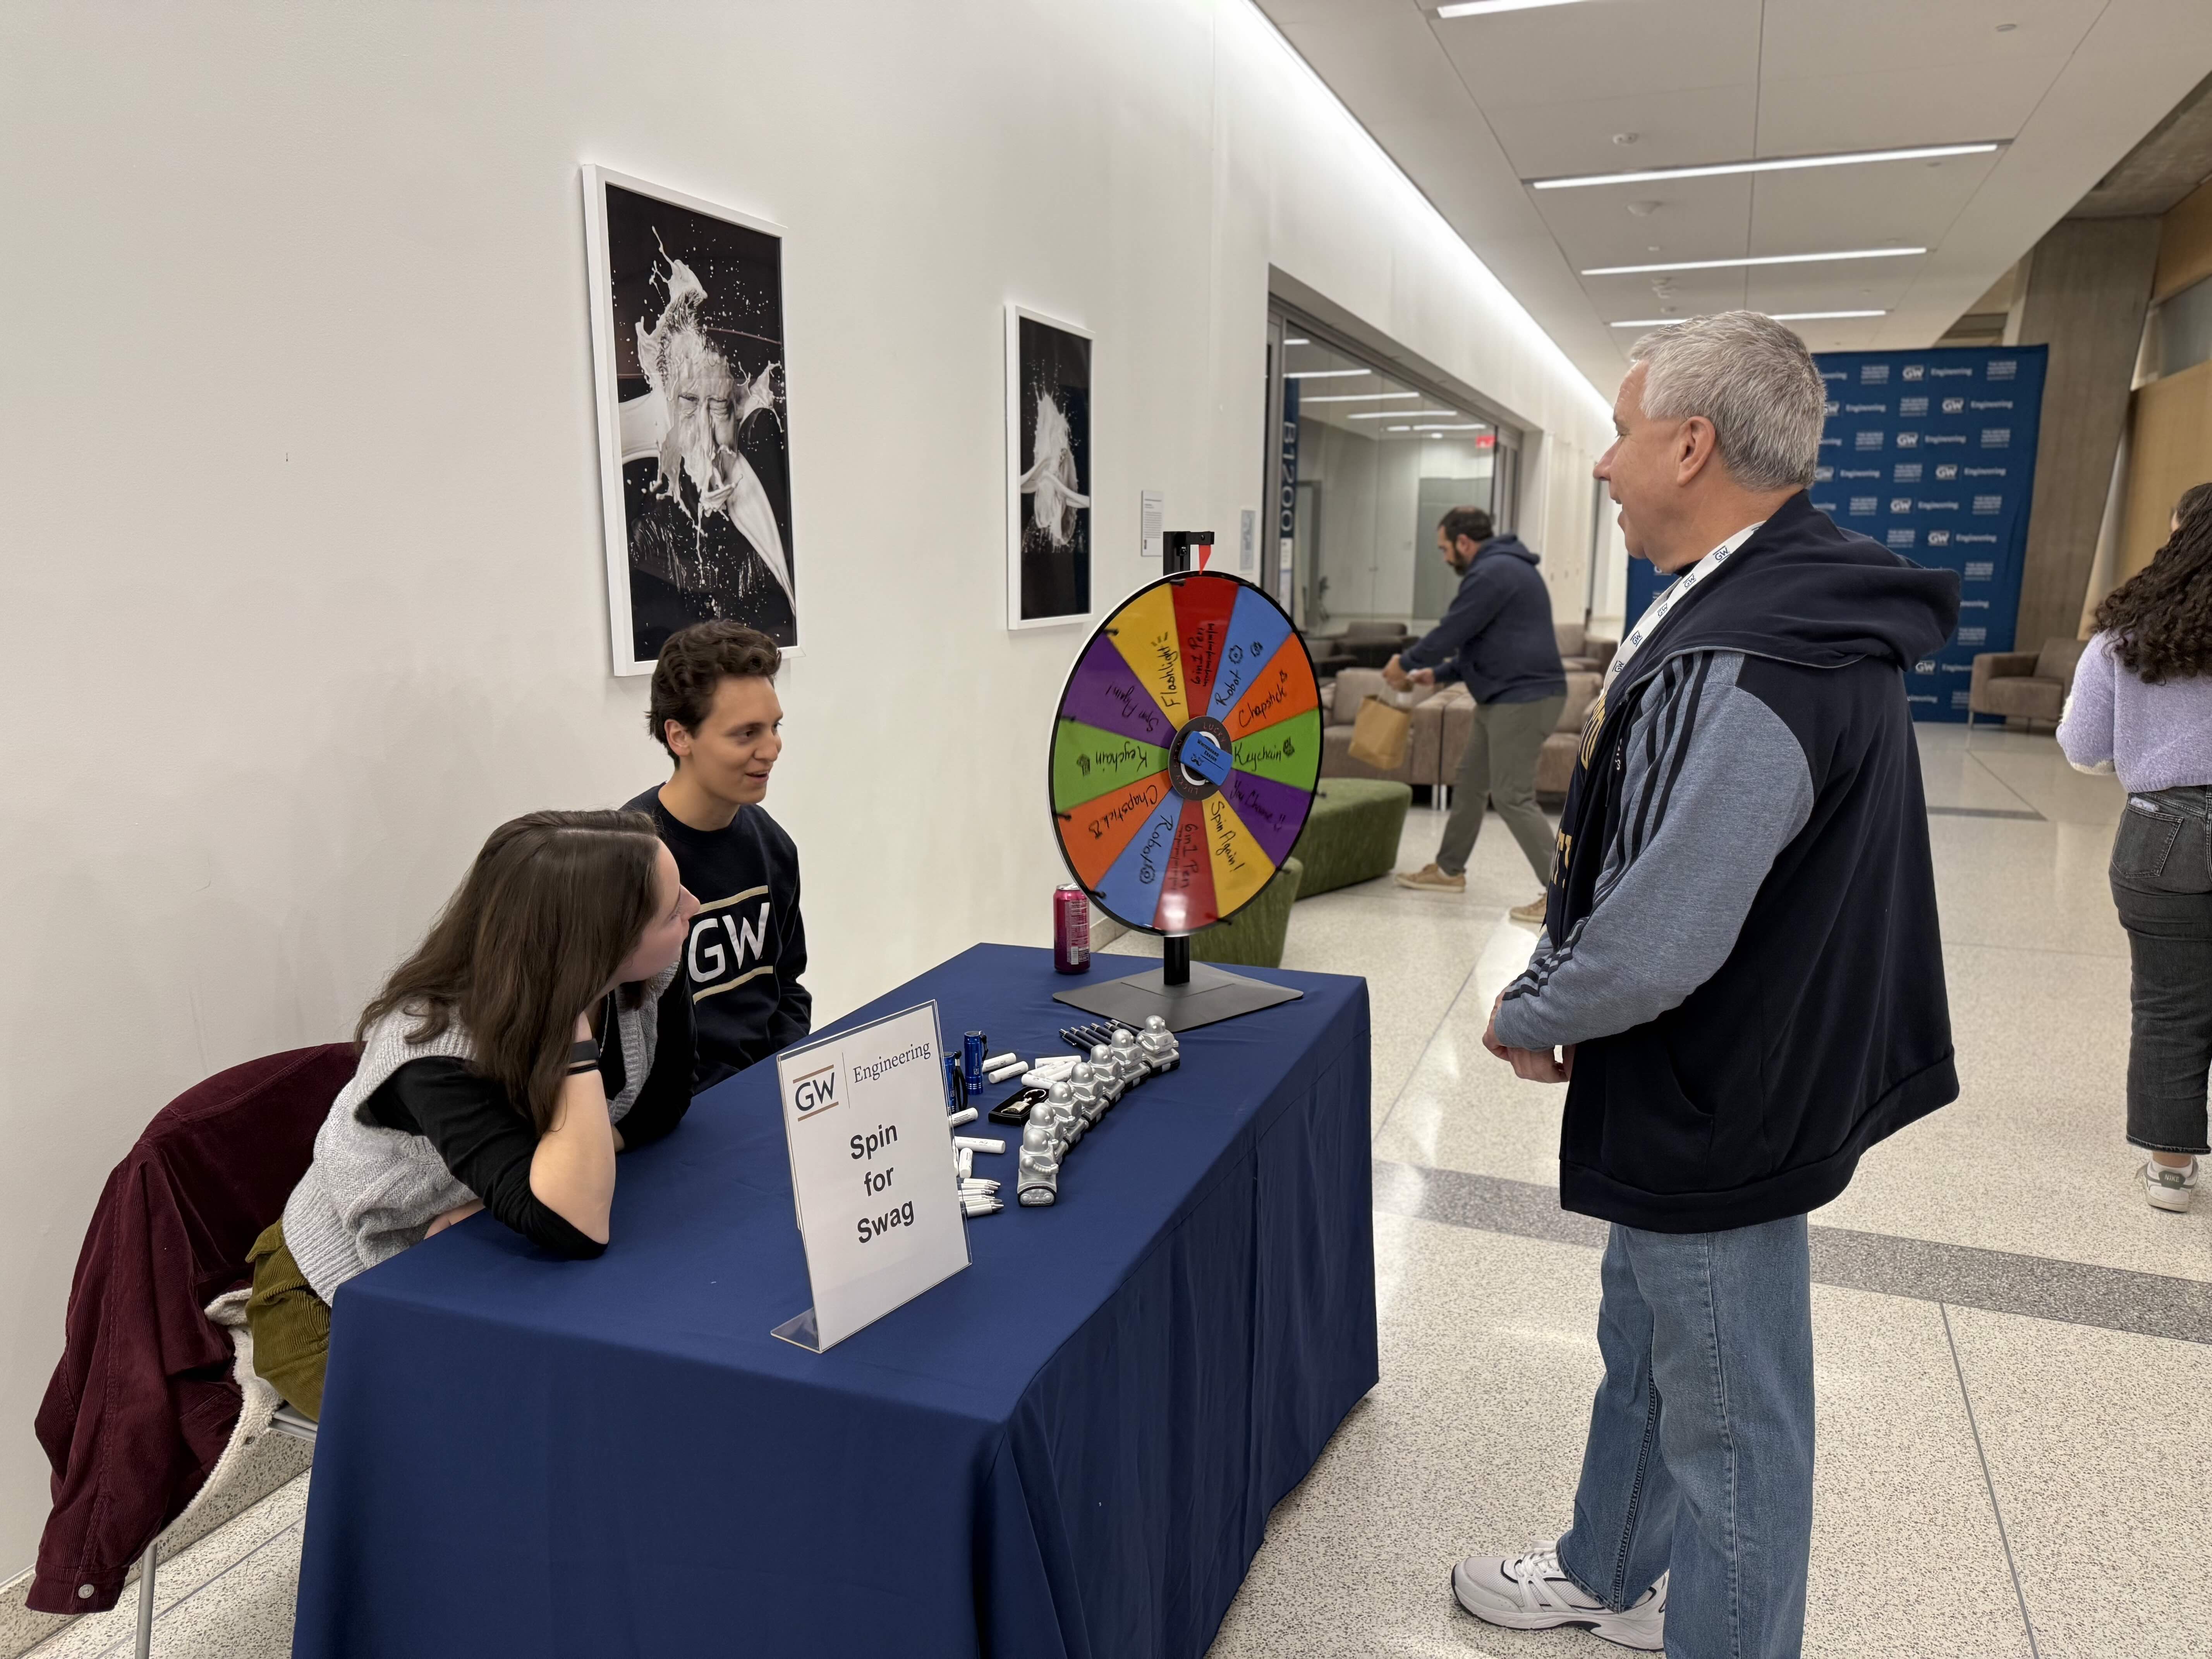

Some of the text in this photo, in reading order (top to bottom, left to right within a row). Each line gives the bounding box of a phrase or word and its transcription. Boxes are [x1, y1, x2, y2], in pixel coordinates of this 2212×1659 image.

[1902, 367, 1924, 380] GW
[1942, 398, 1964, 412] GW
[1897, 433, 1918, 447] GW
[1936, 465, 1958, 479] GW
[1890, 499, 1911, 512] GW
[1927, 531, 1949, 544] GW
[1715, 547, 1729, 561] GW
[1684, 575, 1696, 589] GW
[1657, 603, 1668, 617] GW
[1632, 632, 1642, 645] GW
[1157, 646, 1181, 707] Flashlight
[1614, 660, 1625, 673] GW
[1915, 661, 1935, 673] GW
[1214, 669, 1241, 706] Robot
[1239, 684, 1287, 728] Chapstick
[1139, 710, 1159, 732] Spin
[1096, 740, 1147, 772] Keychain
[1234, 742, 1281, 772] Keychain
[1104, 784, 1158, 829] Chapstick
[1211, 801, 1227, 832] Spin
[1140, 815, 1173, 864] Robot
[688, 902, 770, 982] GW
[795, 1042, 931, 1111] GW Engineering
[850, 1124, 898, 1160] Spin
[864, 1166, 894, 1197] for
[2164, 1174, 2179, 1182] NIKE
[857, 1200, 914, 1243] Swag
